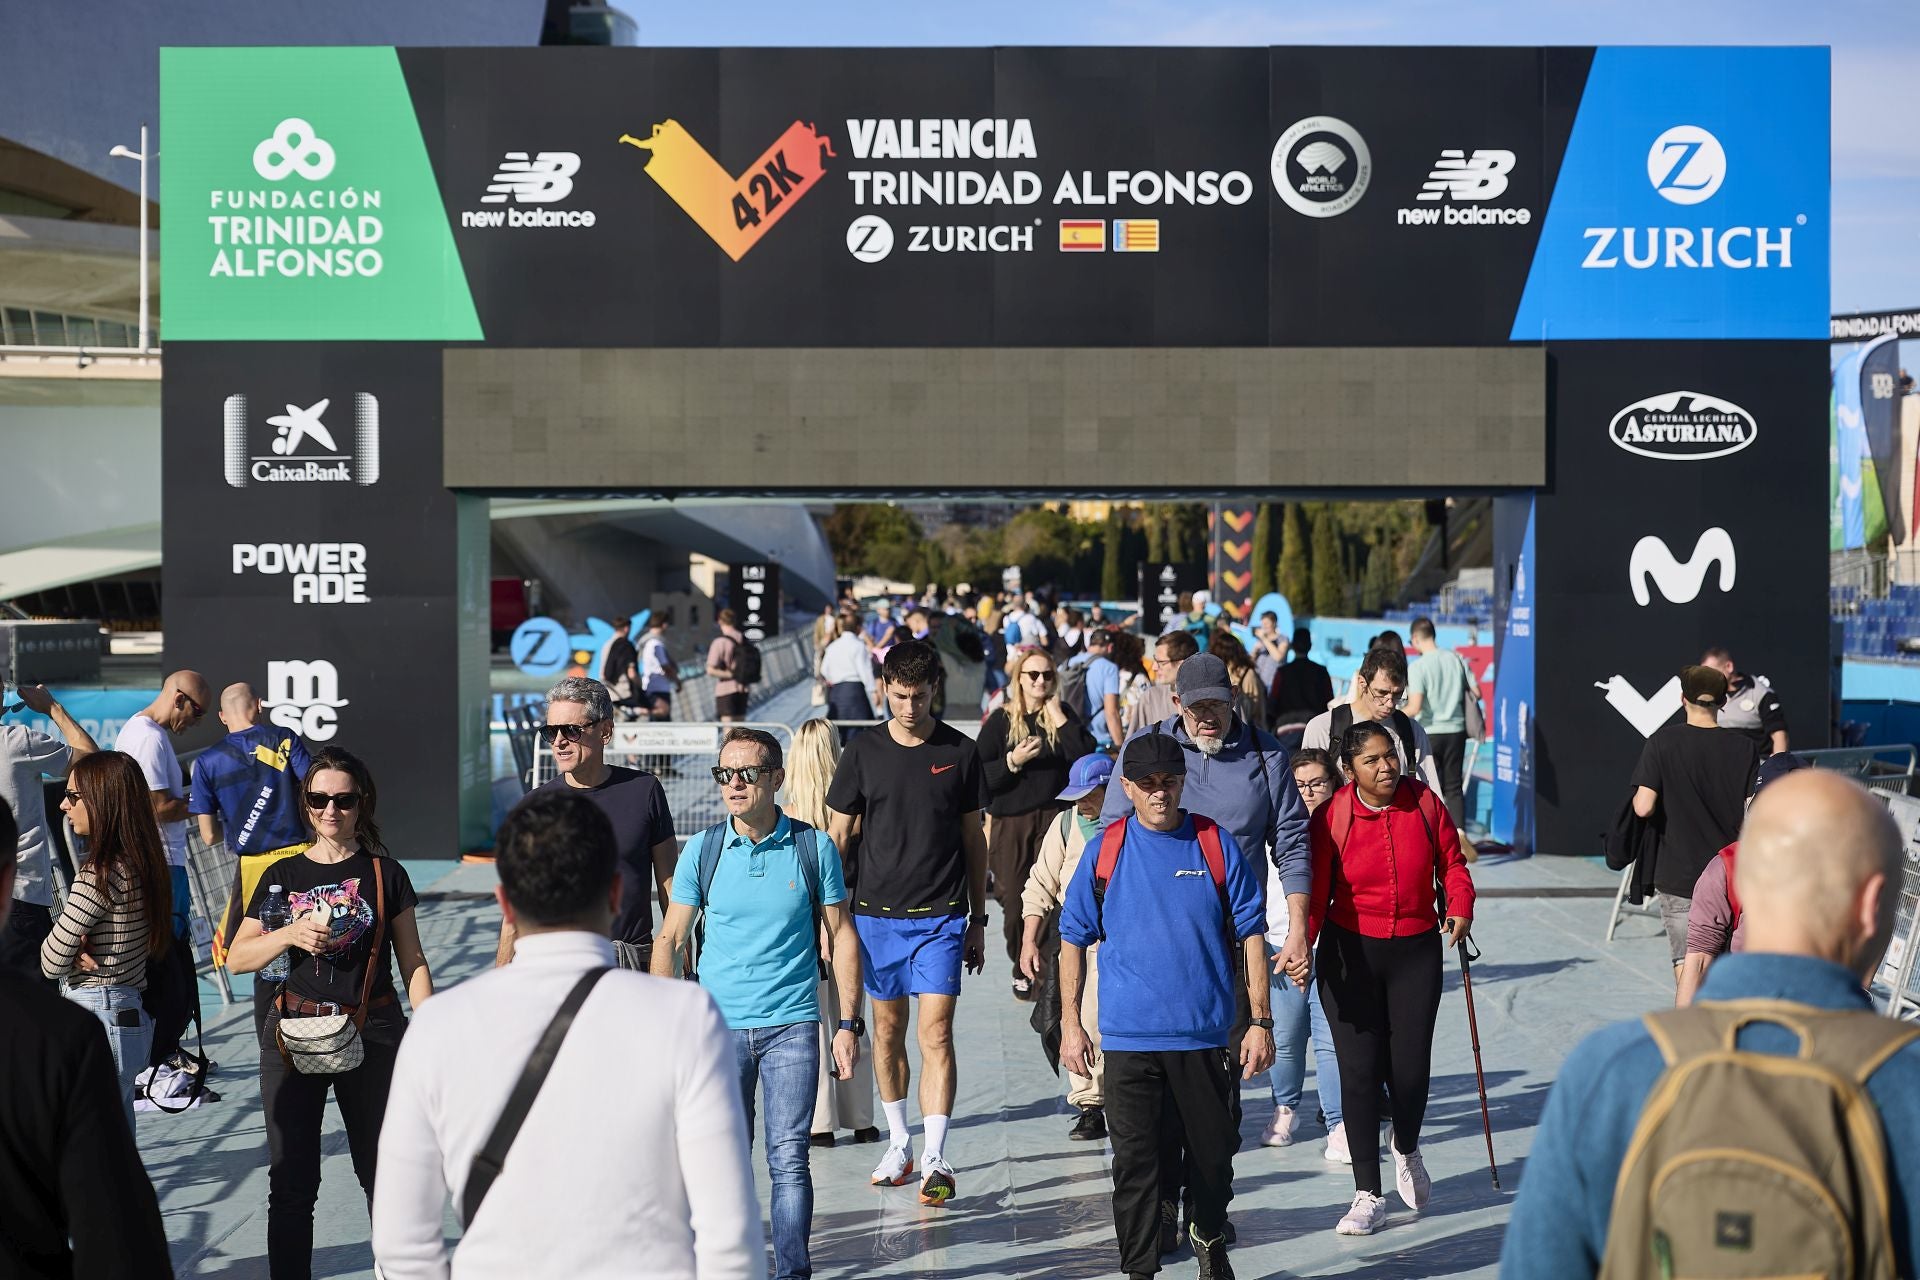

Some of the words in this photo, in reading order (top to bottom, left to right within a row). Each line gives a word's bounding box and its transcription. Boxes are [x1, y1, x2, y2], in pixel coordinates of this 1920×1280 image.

[847, 118, 1037, 159] VALENCIA
[730, 149, 804, 231] 42K
[848, 171, 1043, 206] TRINIDAD
[1053, 171, 1253, 206] ALFONSO
[1299, 184, 1344, 192] ATHLETICS
[1306, 176, 1337, 184] WORLD
[211, 187, 381, 209] FUNDACIÓN
[462, 211, 505, 227] new
[508, 208, 596, 227] balance
[1398, 209, 1442, 225] new
[1443, 205, 1531, 225] balance
[208, 216, 383, 244] TRINIDAD
[907, 225, 1034, 252] ZURICH
[1581, 227, 1793, 269] ZURICH
[209, 248, 383, 277] ALFONSO
[1621, 415, 1746, 443] ASTURIANA
[1644, 413, 1690, 423] CENTRAL
[1692, 413, 1740, 423] LECHERA
[251, 461, 352, 482] CaixaBank
[232, 543, 367, 574] POWER
[293, 574, 367, 604] ADE
[261, 786, 273, 799] BE
[254, 798, 267, 810] TO
[244, 809, 261, 831] RACE
[238, 830, 251, 846] THE
